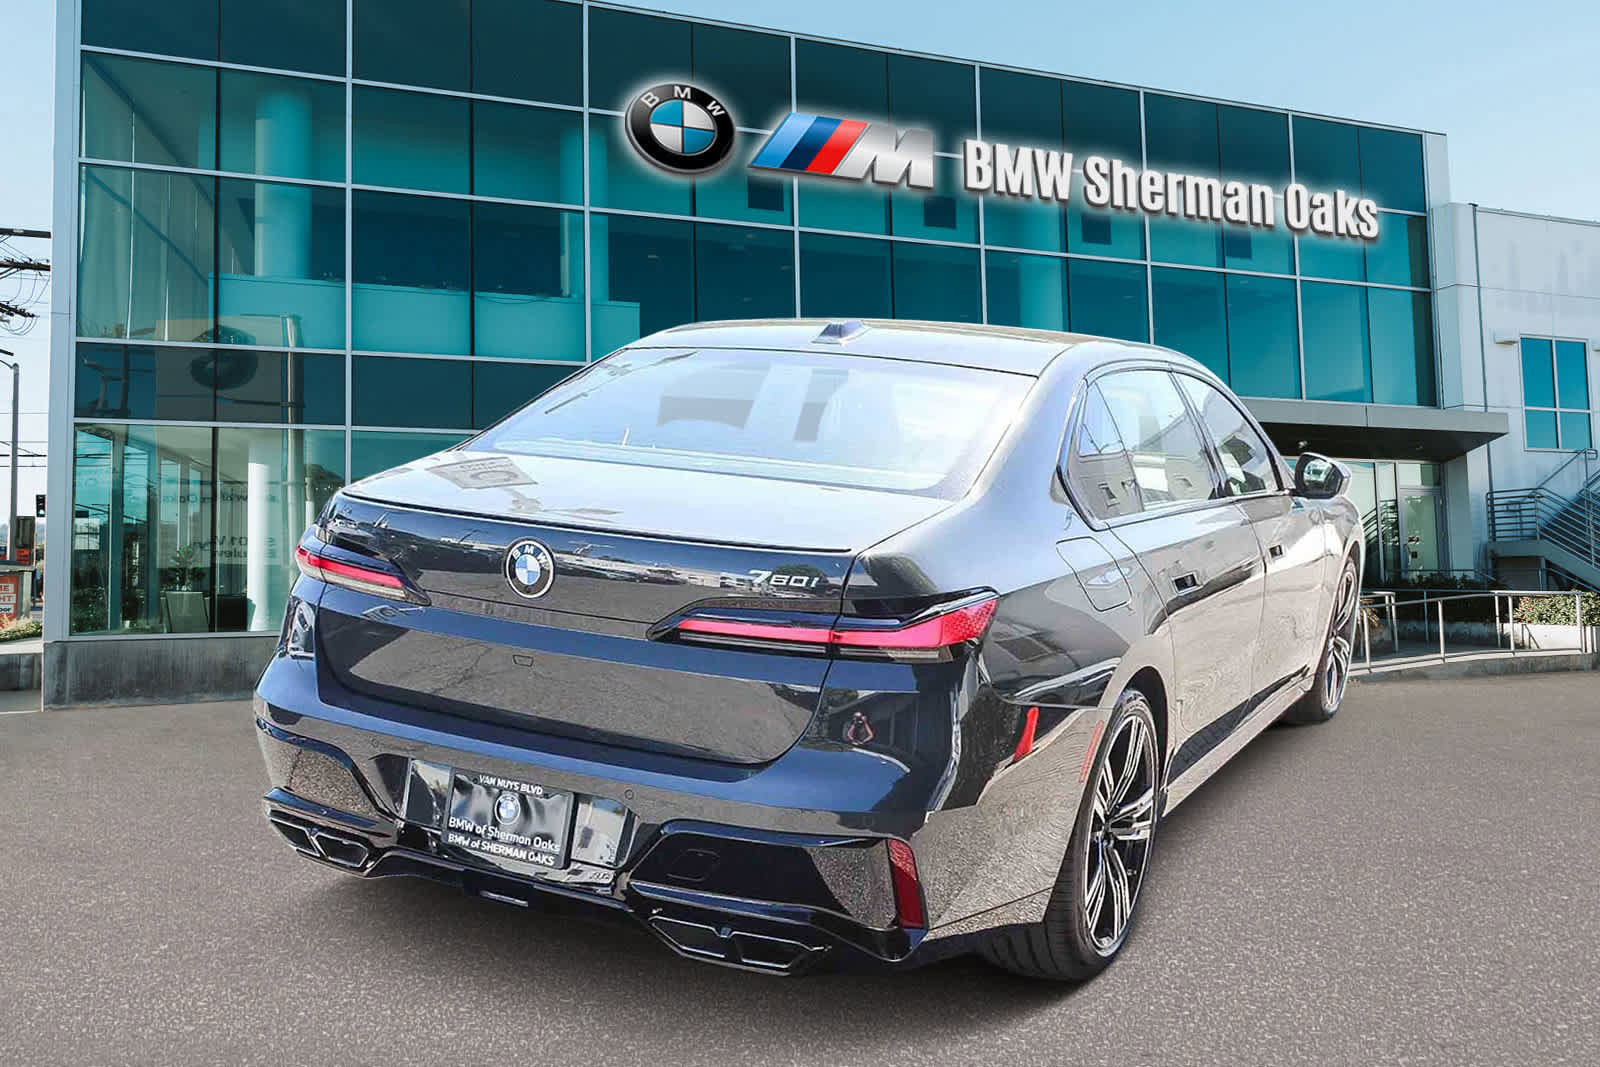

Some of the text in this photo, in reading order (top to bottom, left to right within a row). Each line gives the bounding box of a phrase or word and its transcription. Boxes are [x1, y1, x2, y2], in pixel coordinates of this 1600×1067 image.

[641, 85, 725, 117] BMW
[963, 139, 1379, 241] BMW Sherman Oaks
[512, 544, 551, 570] BMW
[479, 775, 544, 795] VAN NUYS BLVD
[448, 816, 560, 852] BMW of Sherman Oaks
[448, 833, 555, 866] BMW of SHERMAN OAKS
